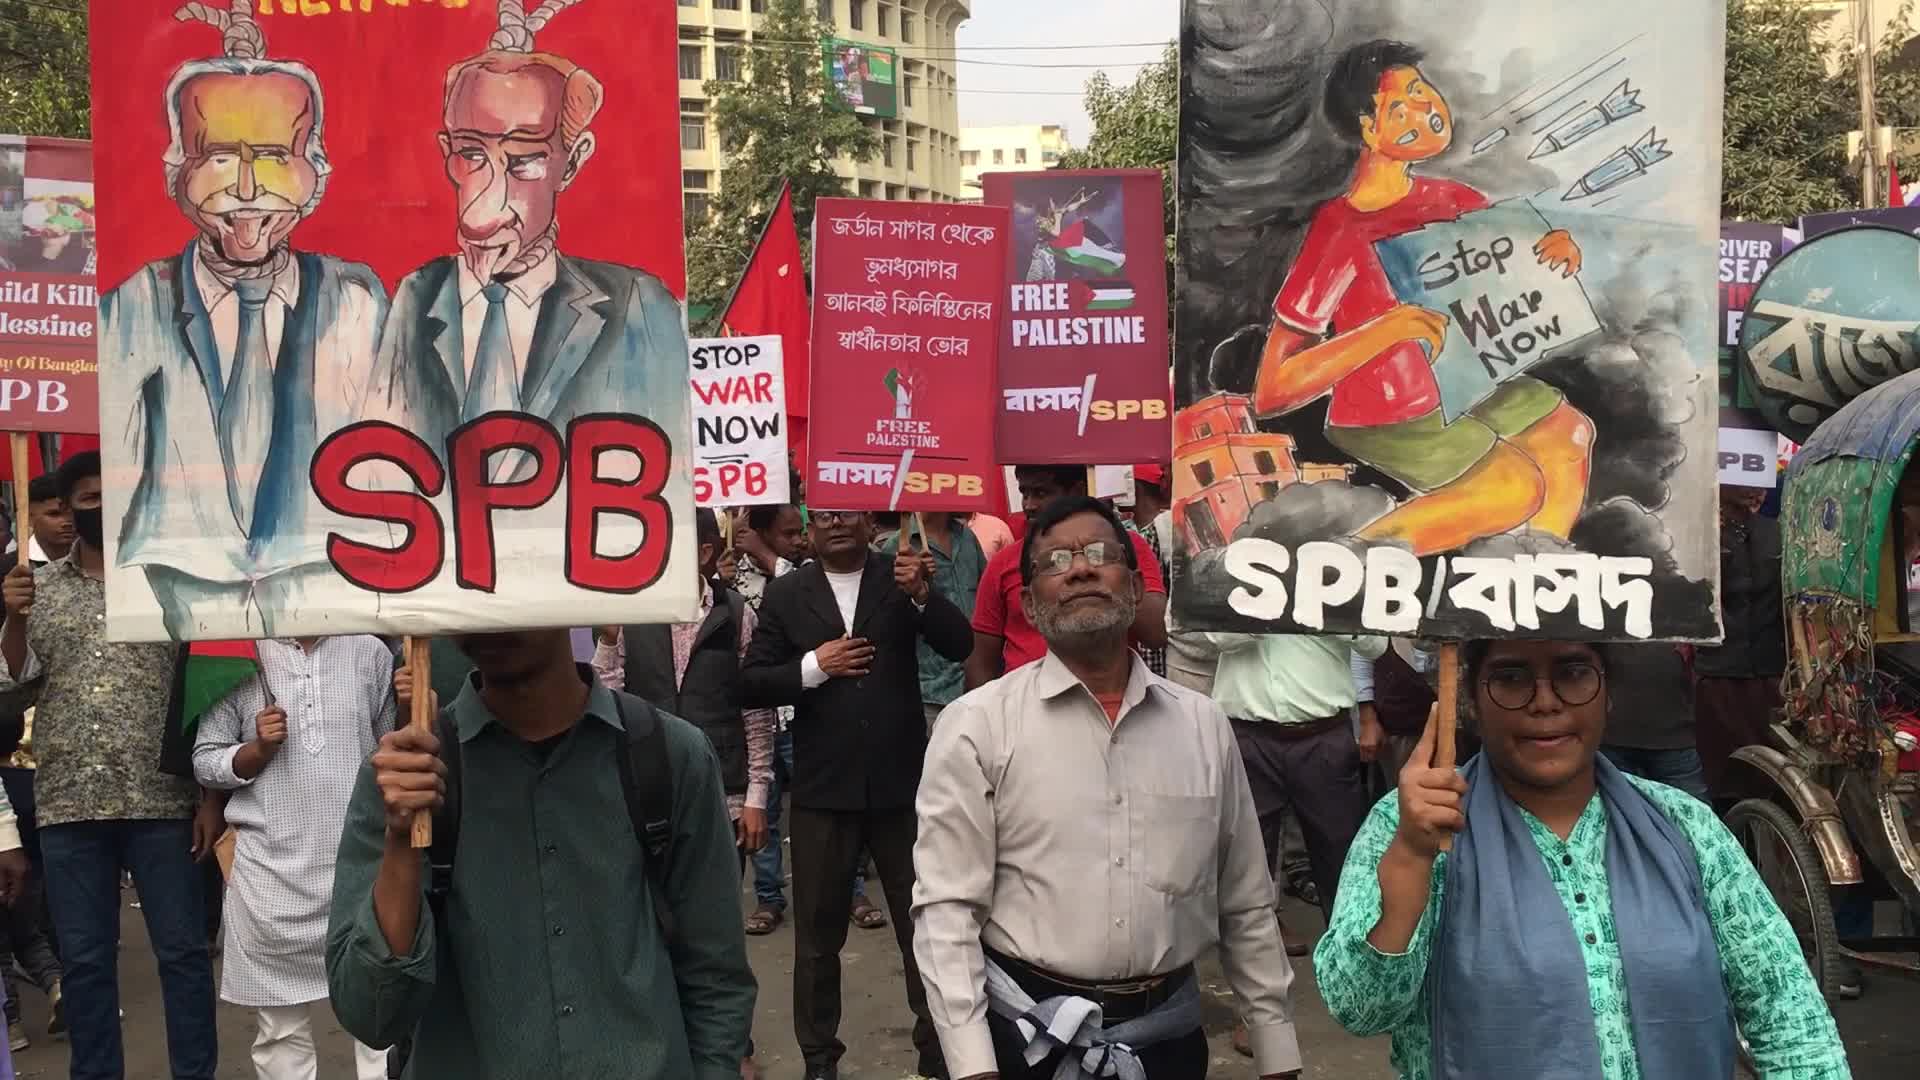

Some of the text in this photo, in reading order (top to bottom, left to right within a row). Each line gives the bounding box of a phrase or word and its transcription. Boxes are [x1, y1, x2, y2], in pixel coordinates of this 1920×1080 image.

[830, 212, 996, 246] জর্ডান সাগর থেকে
[864, 257, 958, 284] ভূমধ্যসাগর
[1416, 236, 1514, 291] Stop
[0, 281, 40, 305] ild
[893, 290, 992, 320] ফিলিস্তিনের
[1011, 283, 1069, 311] FREE
[837, 326, 970, 357] স্বাধীনতার ভোর
[1012, 316, 1146, 347] PALESTINE
[692, 344, 761, 370] STOP
[691, 372, 774, 405] WAR
[697, 412, 780, 446] NOW
[866, 432, 940, 448] PALESTINE
[876, 419, 932, 434] FREE
[694, 462, 768, 502] SPB
[310, 410, 673, 594] SPB
